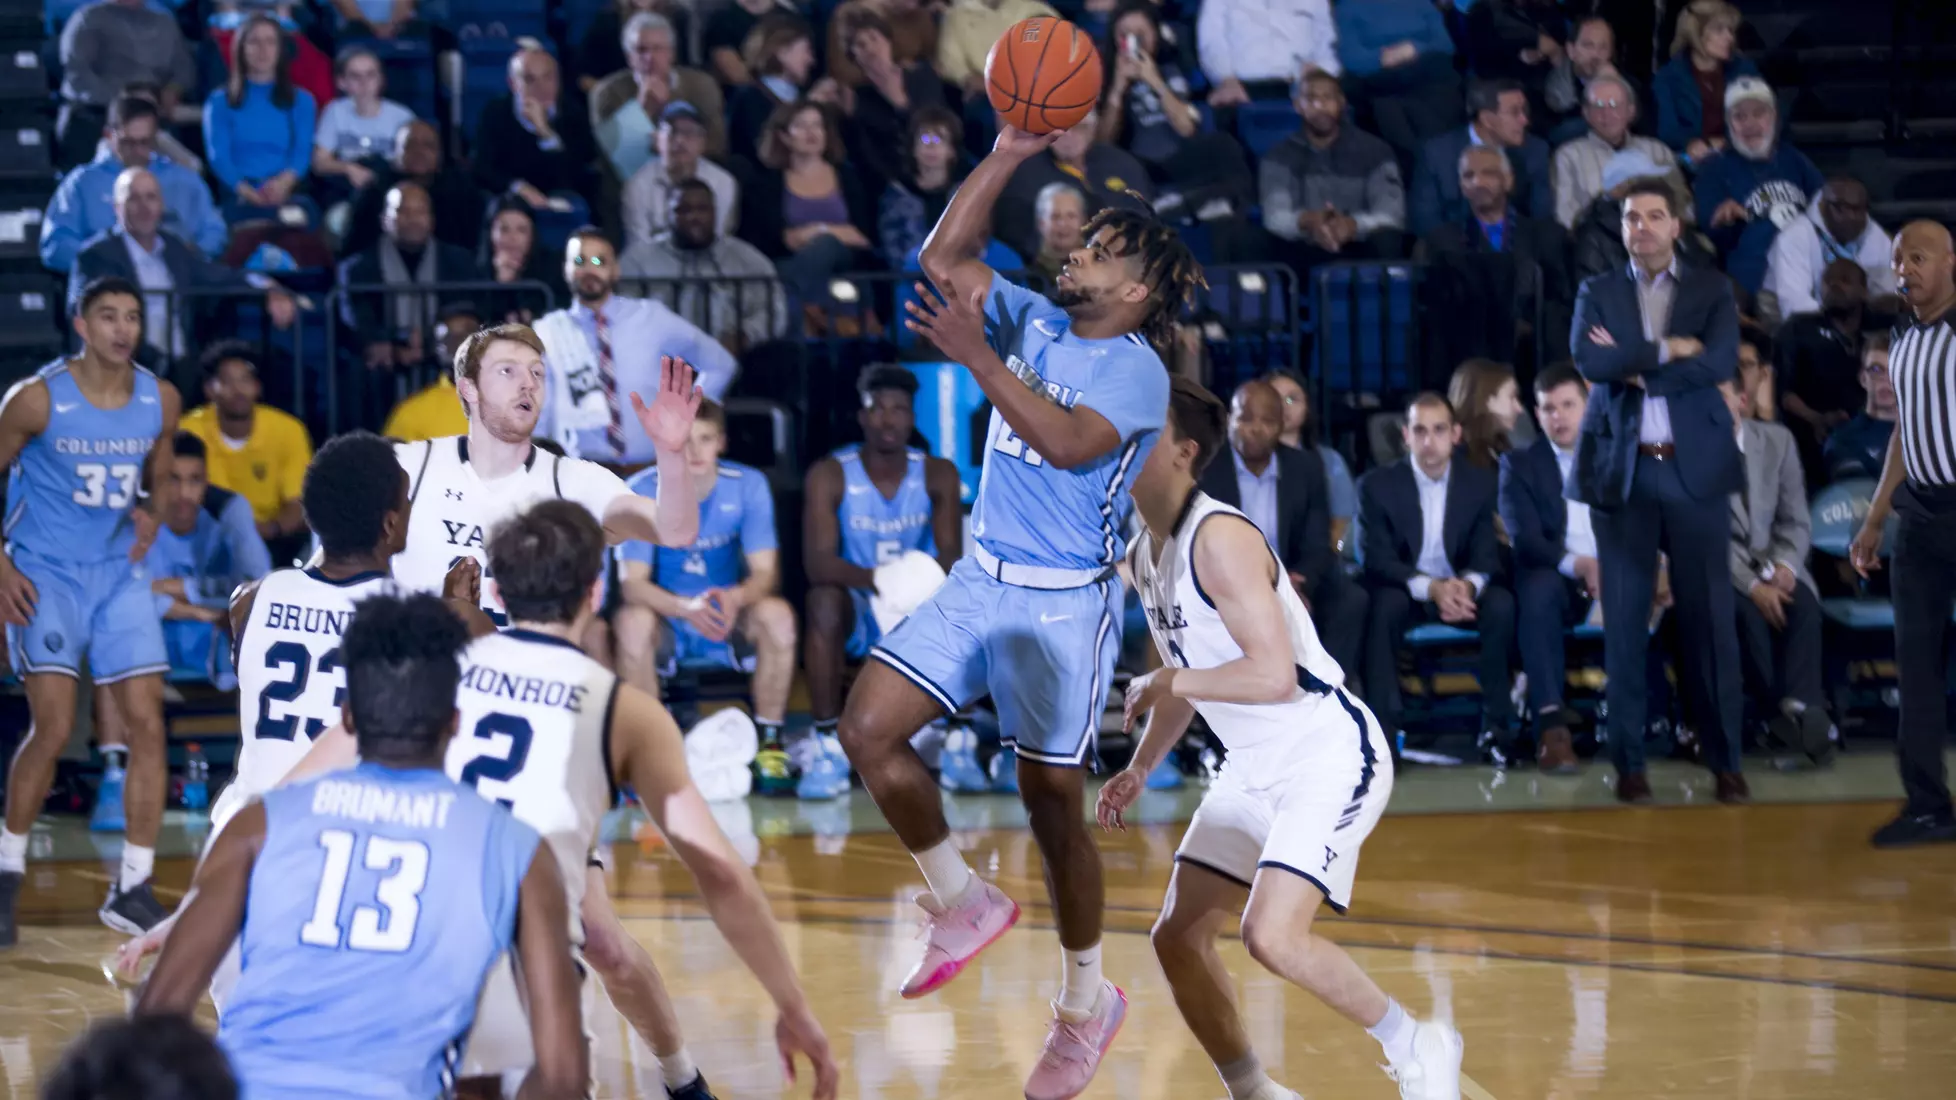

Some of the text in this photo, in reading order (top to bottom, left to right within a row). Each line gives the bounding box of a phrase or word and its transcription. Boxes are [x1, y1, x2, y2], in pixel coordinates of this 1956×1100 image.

[72, 461, 139, 509] 33
[442, 519, 485, 549] YA
[265, 602, 357, 636] BRUN
[460, 711, 534, 812] 2
[311, 779, 458, 829] BRUMANT
[299, 829, 431, 954] 13
